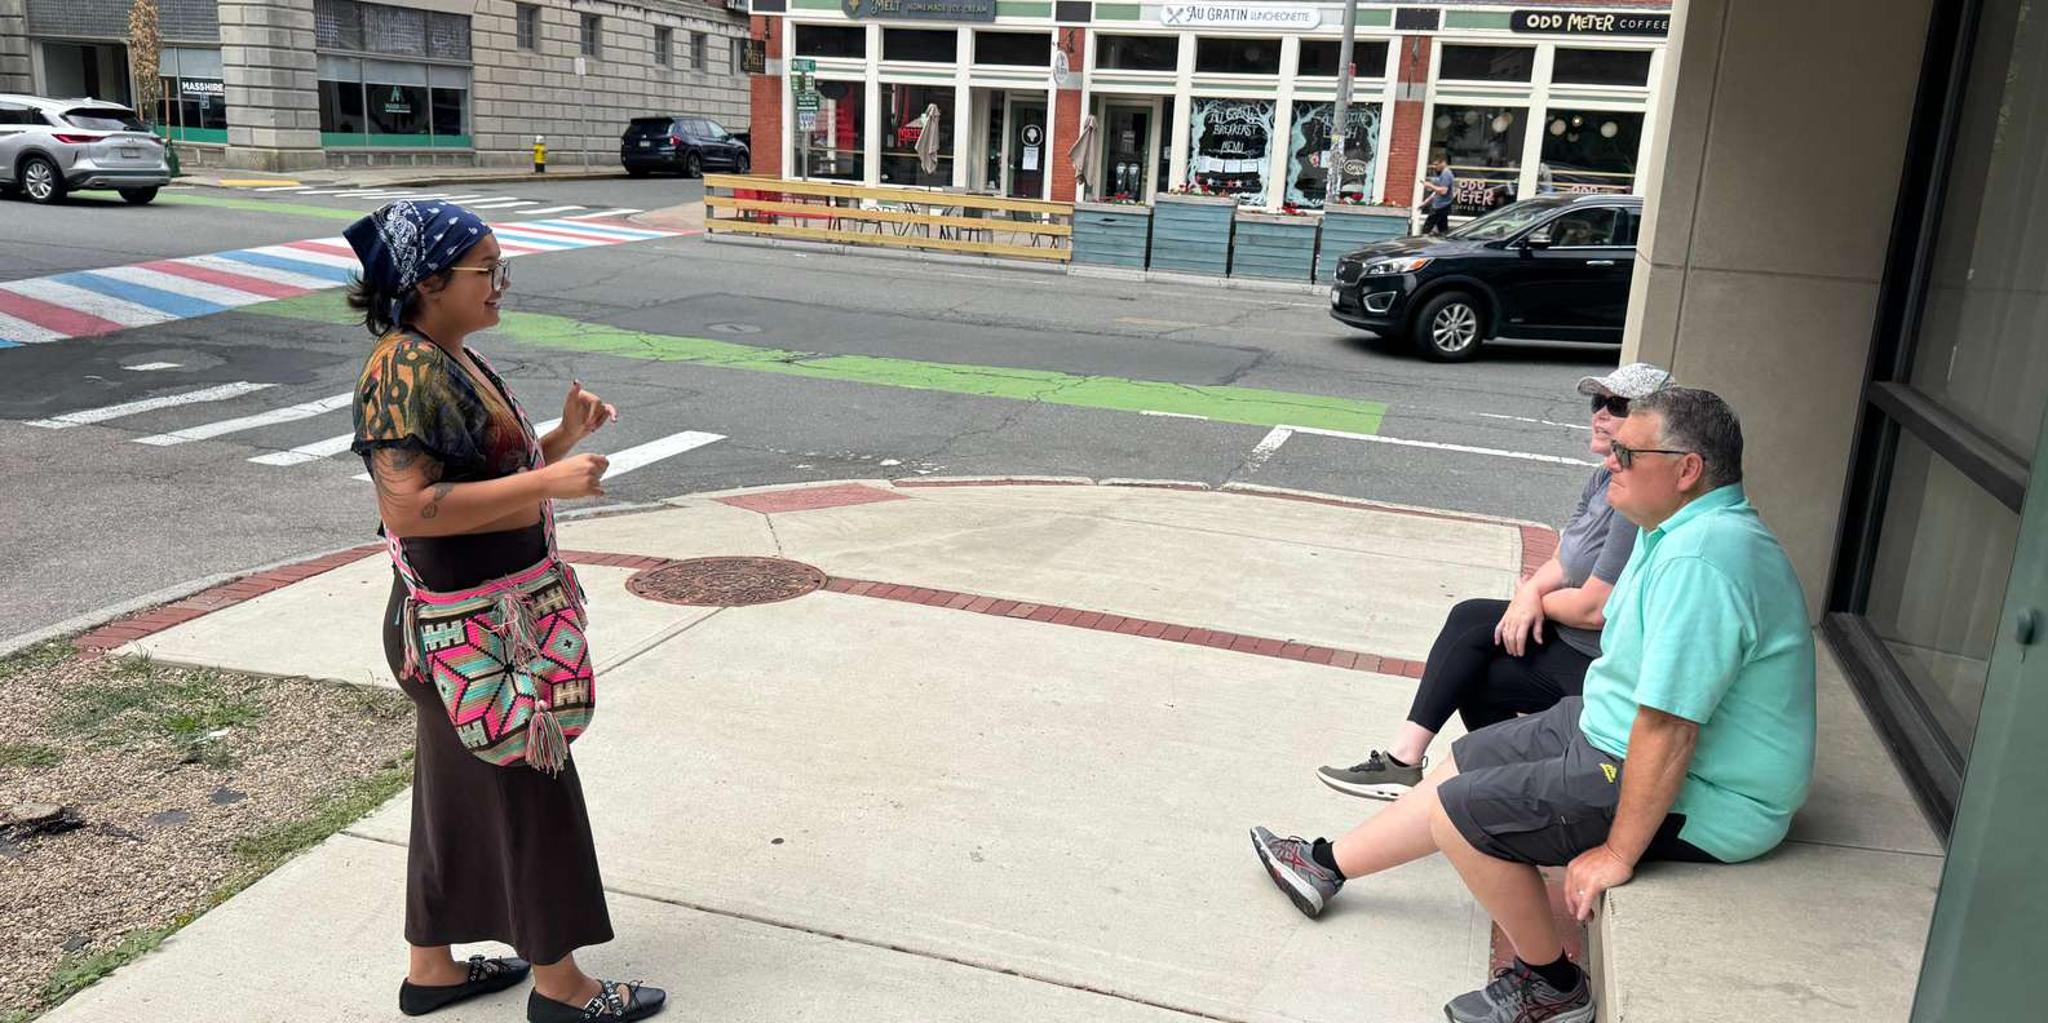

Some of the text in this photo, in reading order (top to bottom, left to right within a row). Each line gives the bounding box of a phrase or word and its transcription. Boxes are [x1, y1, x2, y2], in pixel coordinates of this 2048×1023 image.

[1187, 5, 1310, 22] AU GRATIN LUNCHEONETTE
[1526, 12, 1669, 32] ODD METER COFFEE
